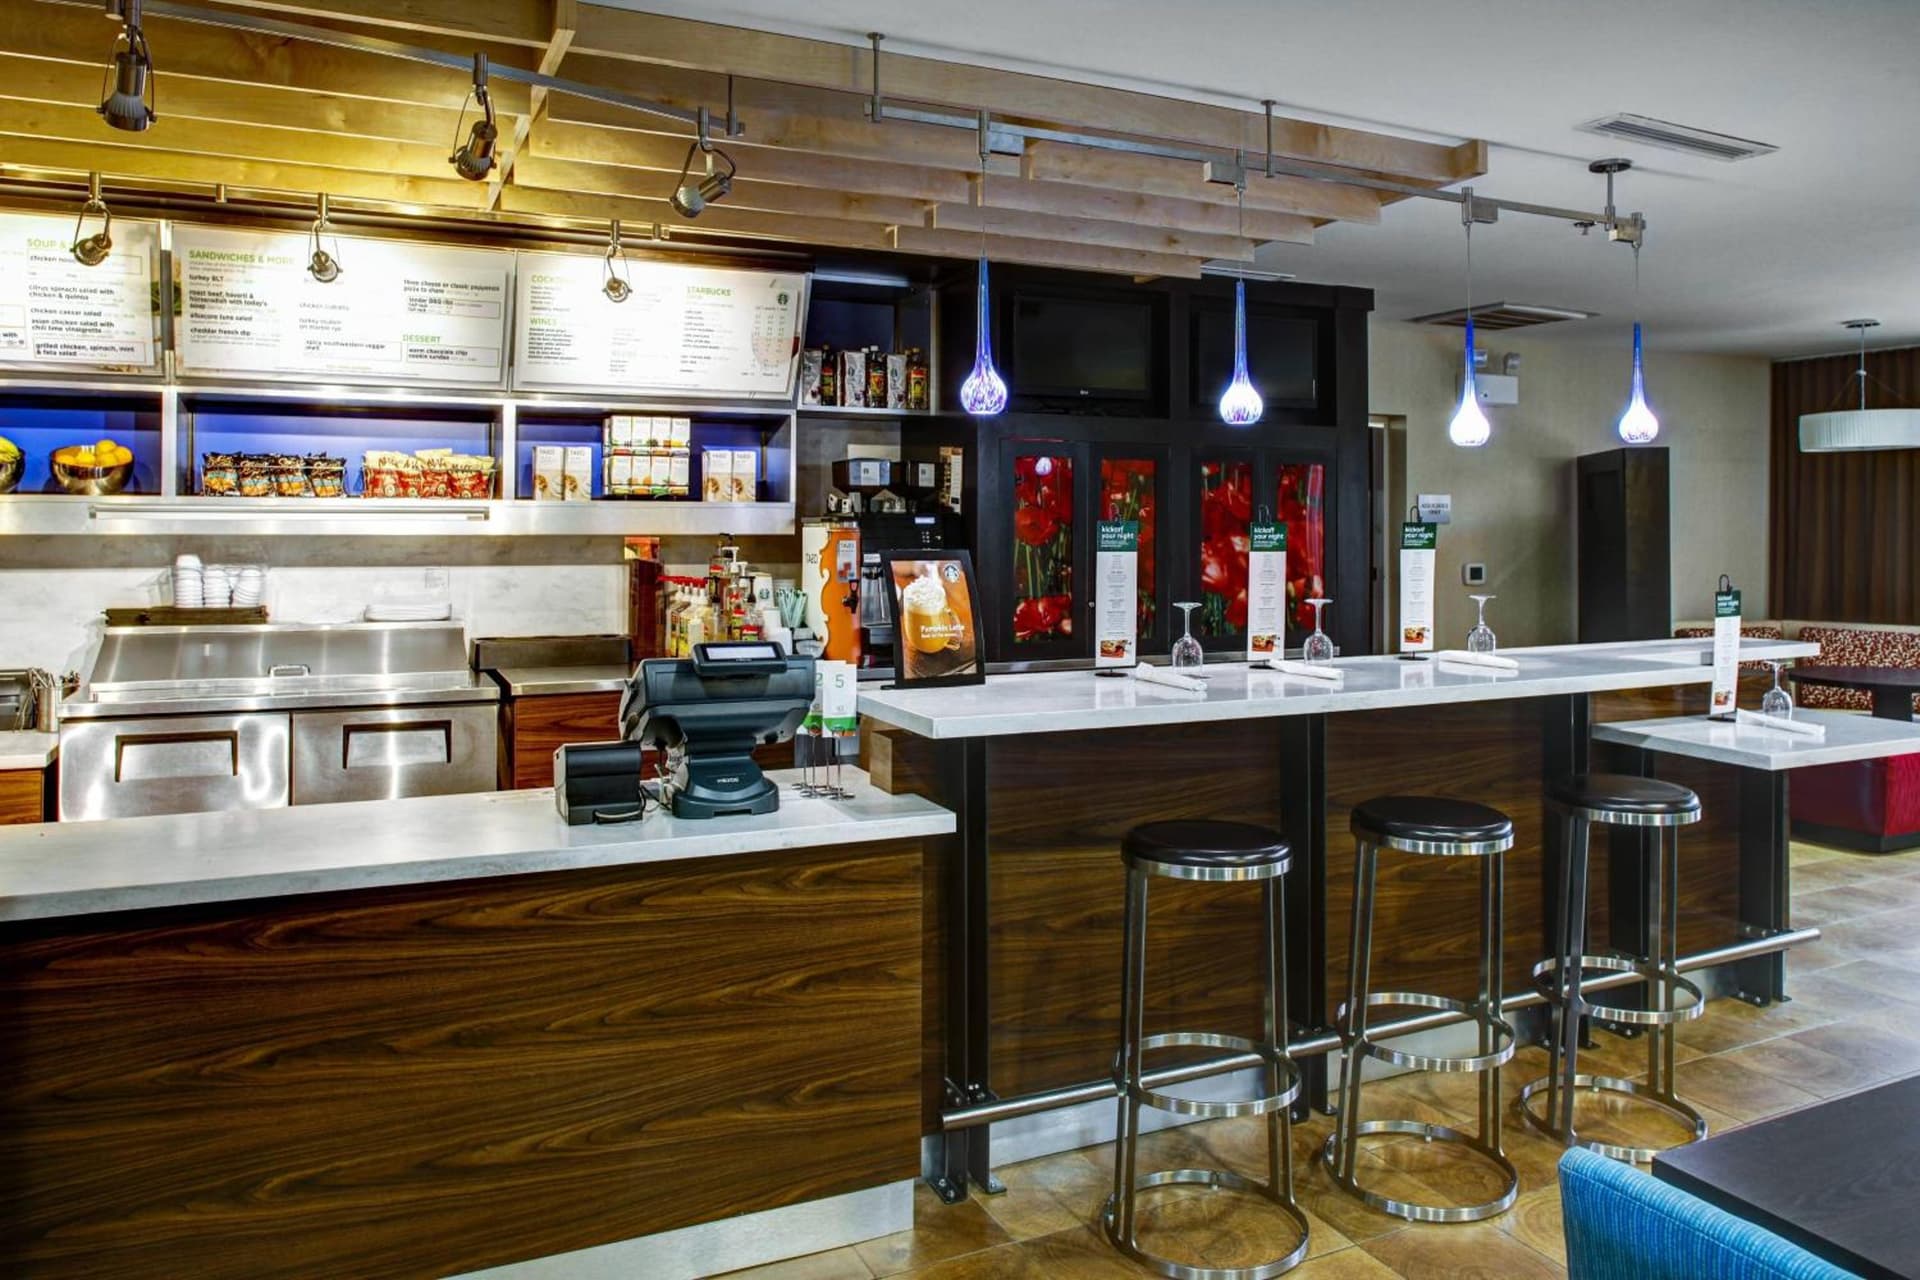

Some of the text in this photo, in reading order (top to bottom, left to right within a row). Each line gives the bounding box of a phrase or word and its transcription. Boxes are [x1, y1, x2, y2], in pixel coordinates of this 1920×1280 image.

[189, 250, 256, 263] SANDWICHES
[402, 334, 441, 344] DESSERT
[835, 674, 845, 689] 5
